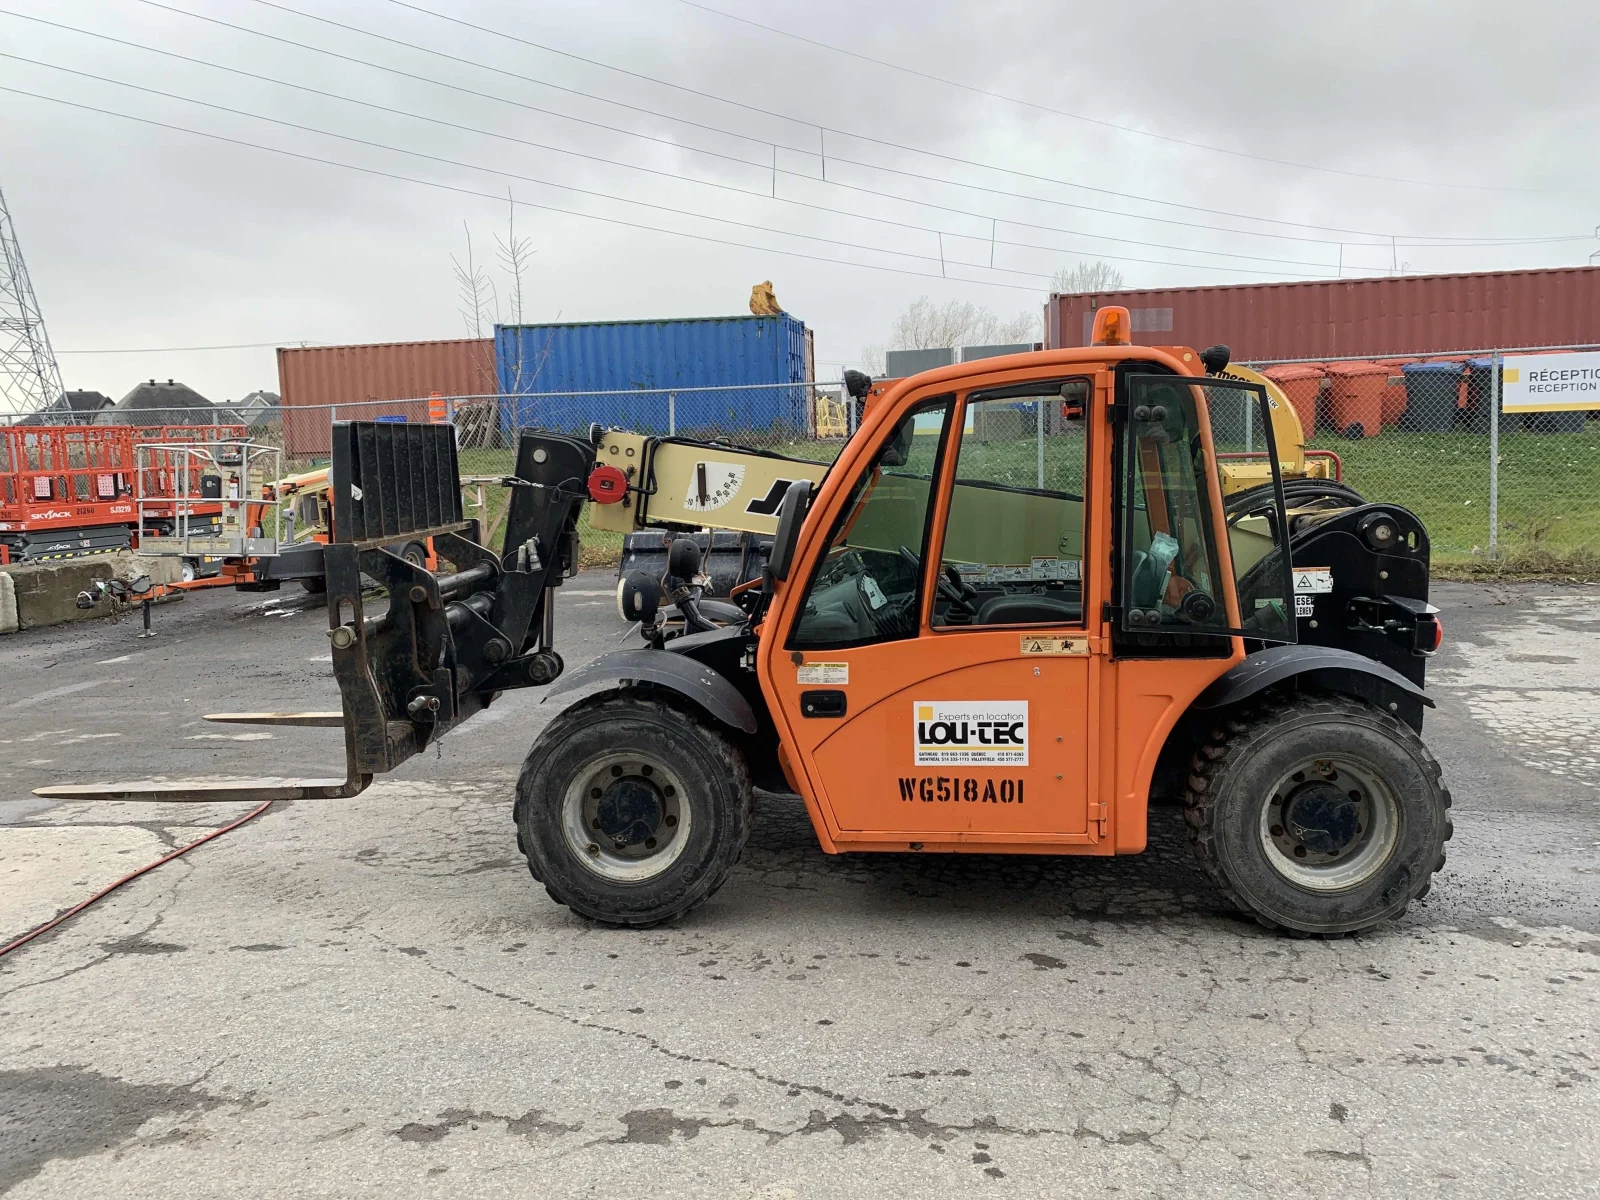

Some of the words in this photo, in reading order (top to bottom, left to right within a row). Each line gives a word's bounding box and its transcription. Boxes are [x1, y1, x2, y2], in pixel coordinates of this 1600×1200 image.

[1529, 382, 1597, 393] RECEPTION
[31, 509, 72, 520] SKYJACK
[110, 505, 131, 514] SJ3219
[938, 712, 971, 722] Experts
[986, 712, 1024, 721] location
[898, 777, 1024, 803] WG518A01
